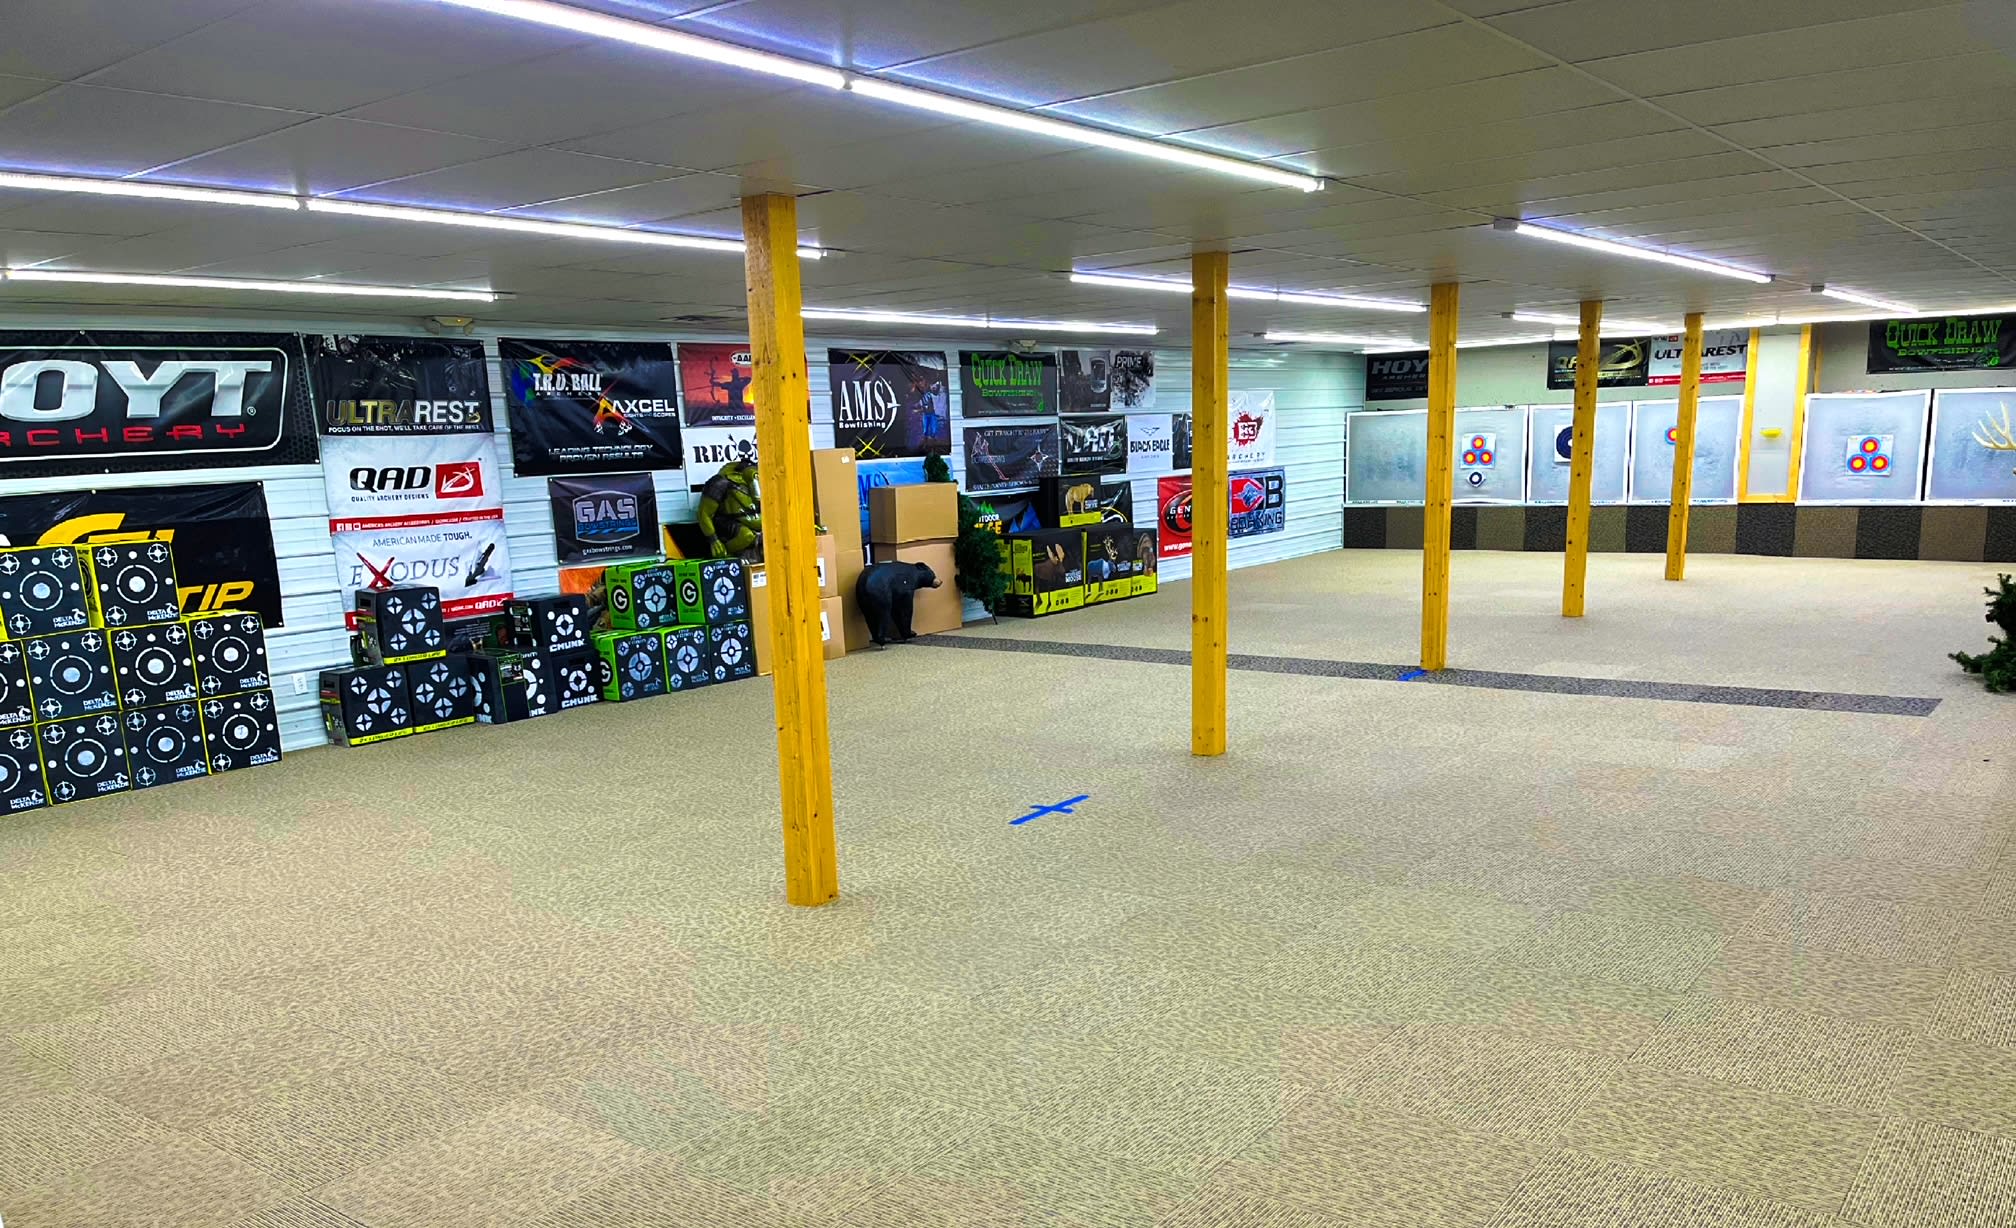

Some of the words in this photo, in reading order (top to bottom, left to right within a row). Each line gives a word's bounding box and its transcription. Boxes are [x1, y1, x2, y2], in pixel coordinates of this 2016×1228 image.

[1885, 320, 1939, 349] QUICK
[1944, 316, 2002, 345] DRAW
[1655, 343, 1748, 360] ULTREST
[1116, 357, 1142, 367] PRIME
[1372, 360, 1428, 375] HOY
[971, 353, 1007, 389] QUICK
[1008, 355, 1043, 386] DRAW
[533, 373, 569, 391] T.R.U.
[571, 373, 602, 391] BALL
[0, 360, 272, 421] OYT
[612, 399, 675, 413] AXCEL
[839, 379, 885, 422] AMS
[326, 400, 481, 426] ULTRAREST
[328, 426, 351, 434] FOCUS
[839, 421, 886, 429] Bowfishing
[0, 423, 245, 447] CHERY
[548, 447, 591, 455] LEADING
[592, 444, 653, 453] TECHNOLOGY
[1130, 440, 1151, 453] BLACK
[1153, 439, 1170, 452] EAGLE
[559, 453, 600, 463] PROVEN
[350, 466, 432, 493] QAD
[377, 494, 403, 502] ARCHERY
[404, 493, 430, 501] DESIGNS
[575, 498, 635, 523] GAS
[1169, 505, 1192, 515] GEN
[372, 537, 418, 547] AMERICAN
[418, 534, 442, 544] MADE
[443, 531, 472, 541] TOUGH.
[347, 552, 461, 588] EXODUS
[147, 608, 167, 616] DELTA
[475, 600, 497, 610] QAD
[53, 615, 73, 623] DELTA
[550, 638, 585, 652] CHUNK
[165, 689, 184, 697] DELTA
[83, 697, 102, 706] DELTA
[561, 694, 599, 709] CHUNK
[249, 752, 268, 761] DELTA
[175, 765, 195, 773] DELTA
[97, 779, 116, 788] DELTA
[10, 796, 31, 805] DELTA
